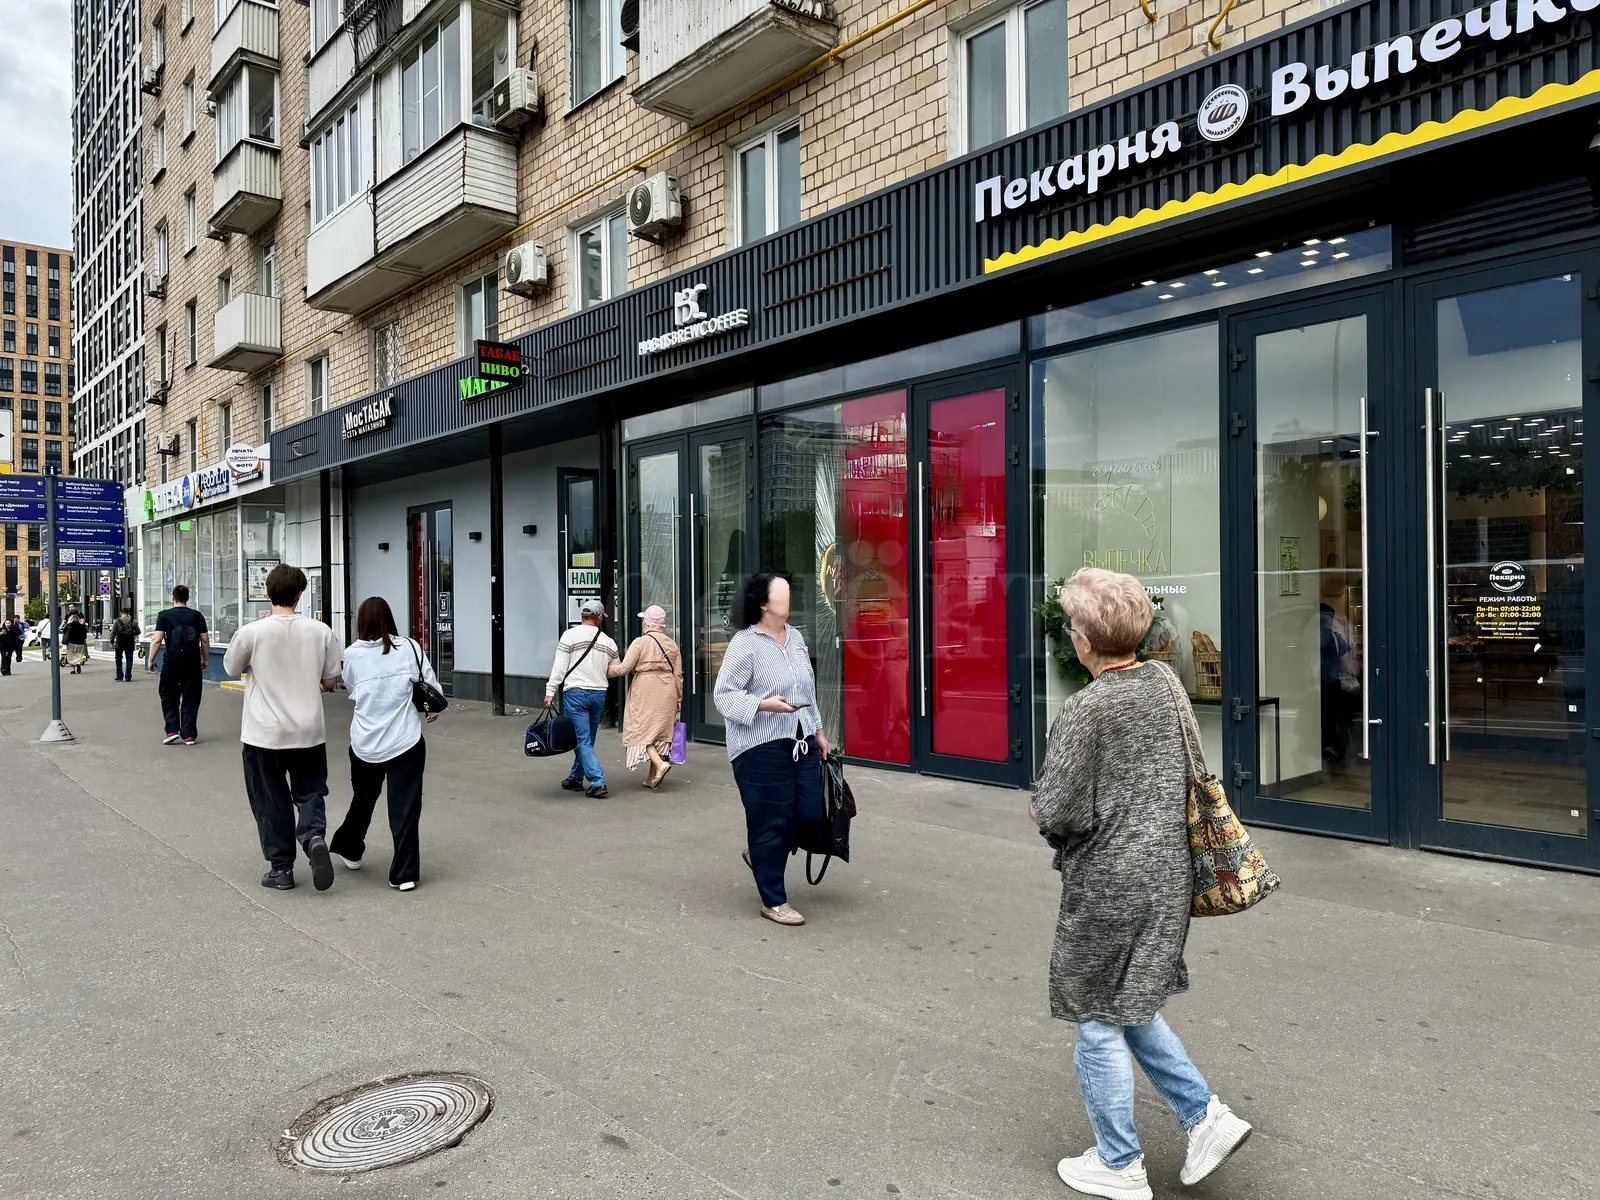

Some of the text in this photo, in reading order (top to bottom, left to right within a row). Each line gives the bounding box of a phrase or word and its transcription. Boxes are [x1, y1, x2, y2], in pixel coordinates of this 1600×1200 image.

[975, 0, 1600, 223] Пекарня Выпечк
[478, 345, 521, 362] ТАБАК
[480, 361, 520, 378] ПИВО
[346, 429, 358, 439] СЕТЬ
[571, 571, 601, 586] НАПИ
[1489, 574, 1526, 582] Пекарня
[436, 622, 452, 632] ТАБАК
